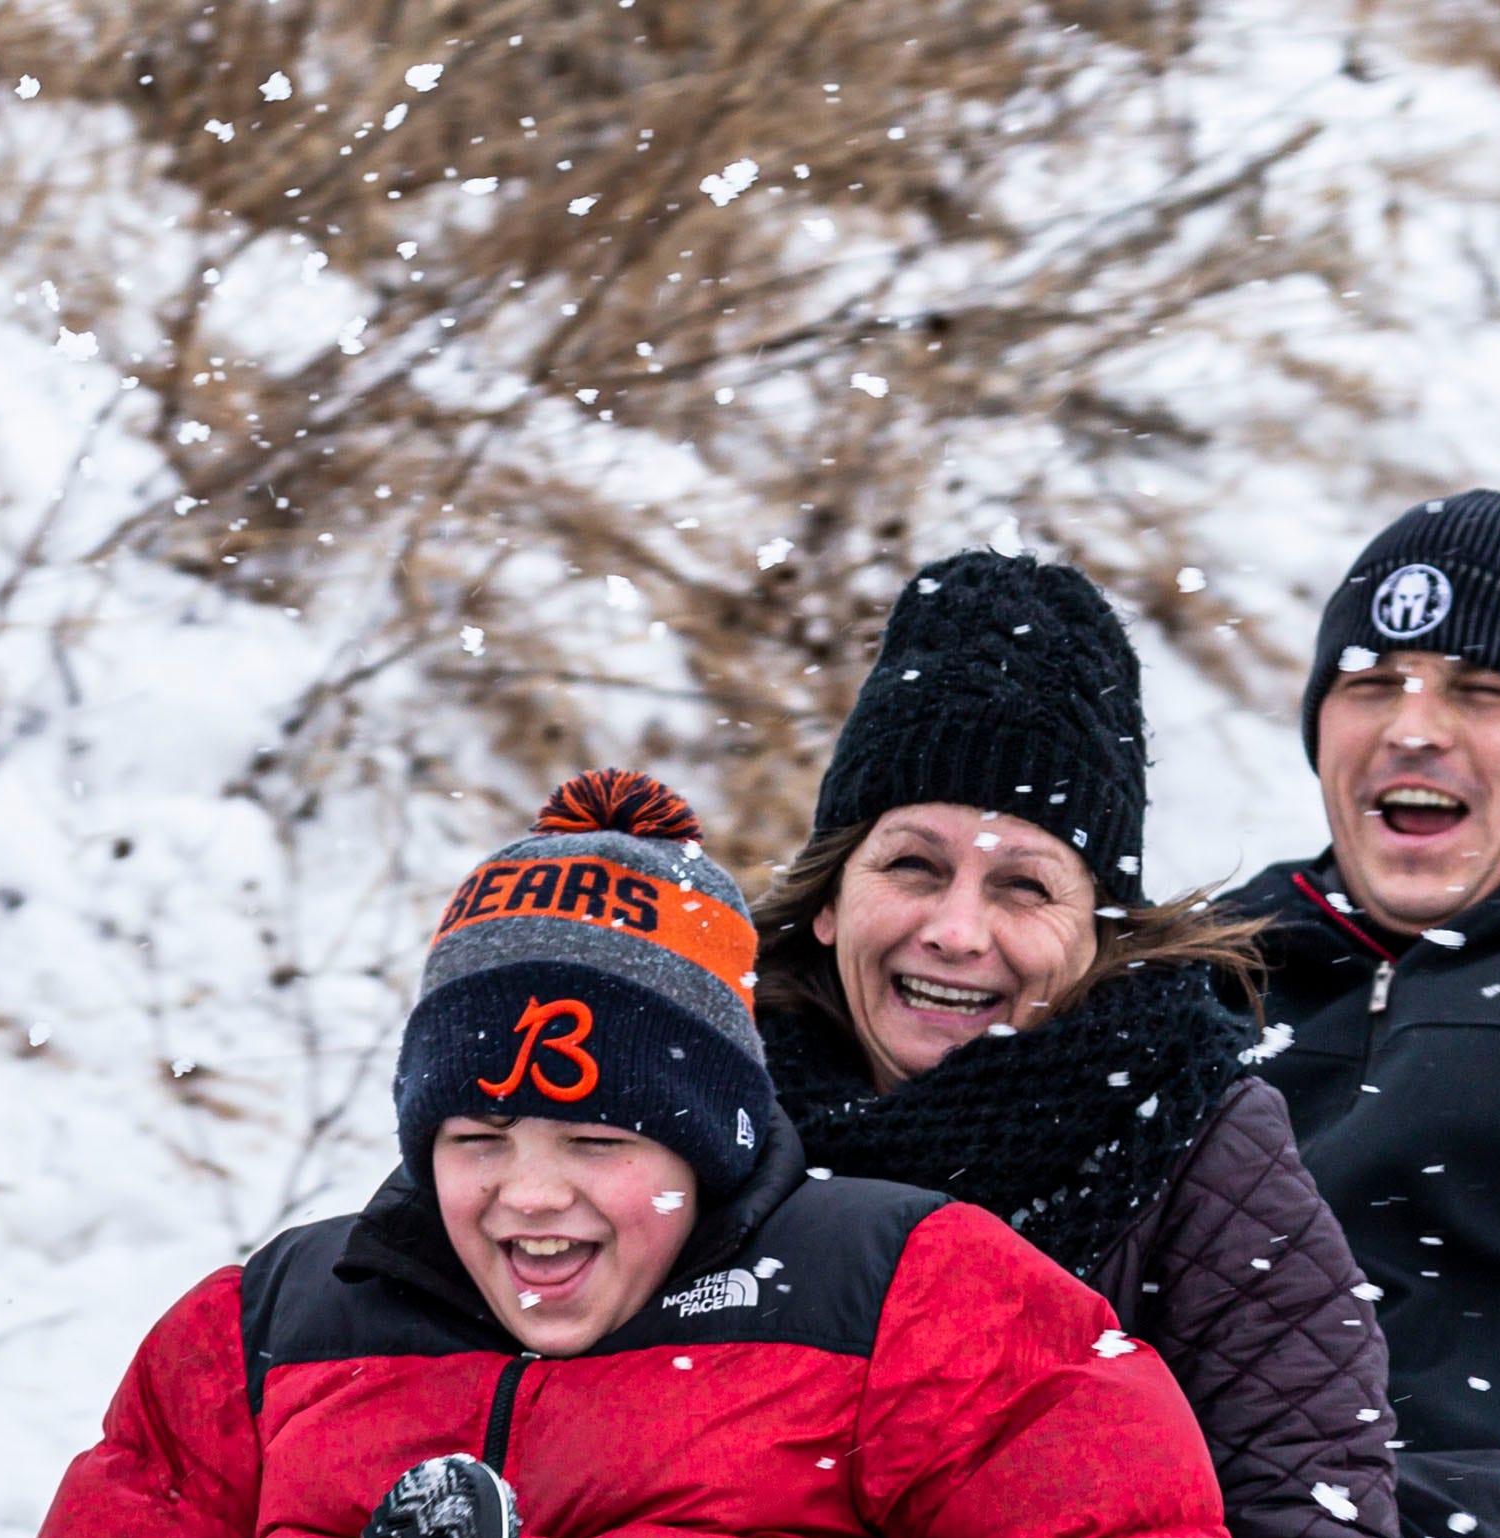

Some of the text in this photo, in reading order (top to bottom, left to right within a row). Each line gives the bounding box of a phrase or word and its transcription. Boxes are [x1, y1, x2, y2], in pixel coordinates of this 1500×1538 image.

[439, 863, 658, 932] BEARS
[478, 996, 600, 1101] B
[693, 1271, 729, 1288] THE
[662, 1283, 726, 1309] NORTH
[679, 1296, 725, 1318] FACE
